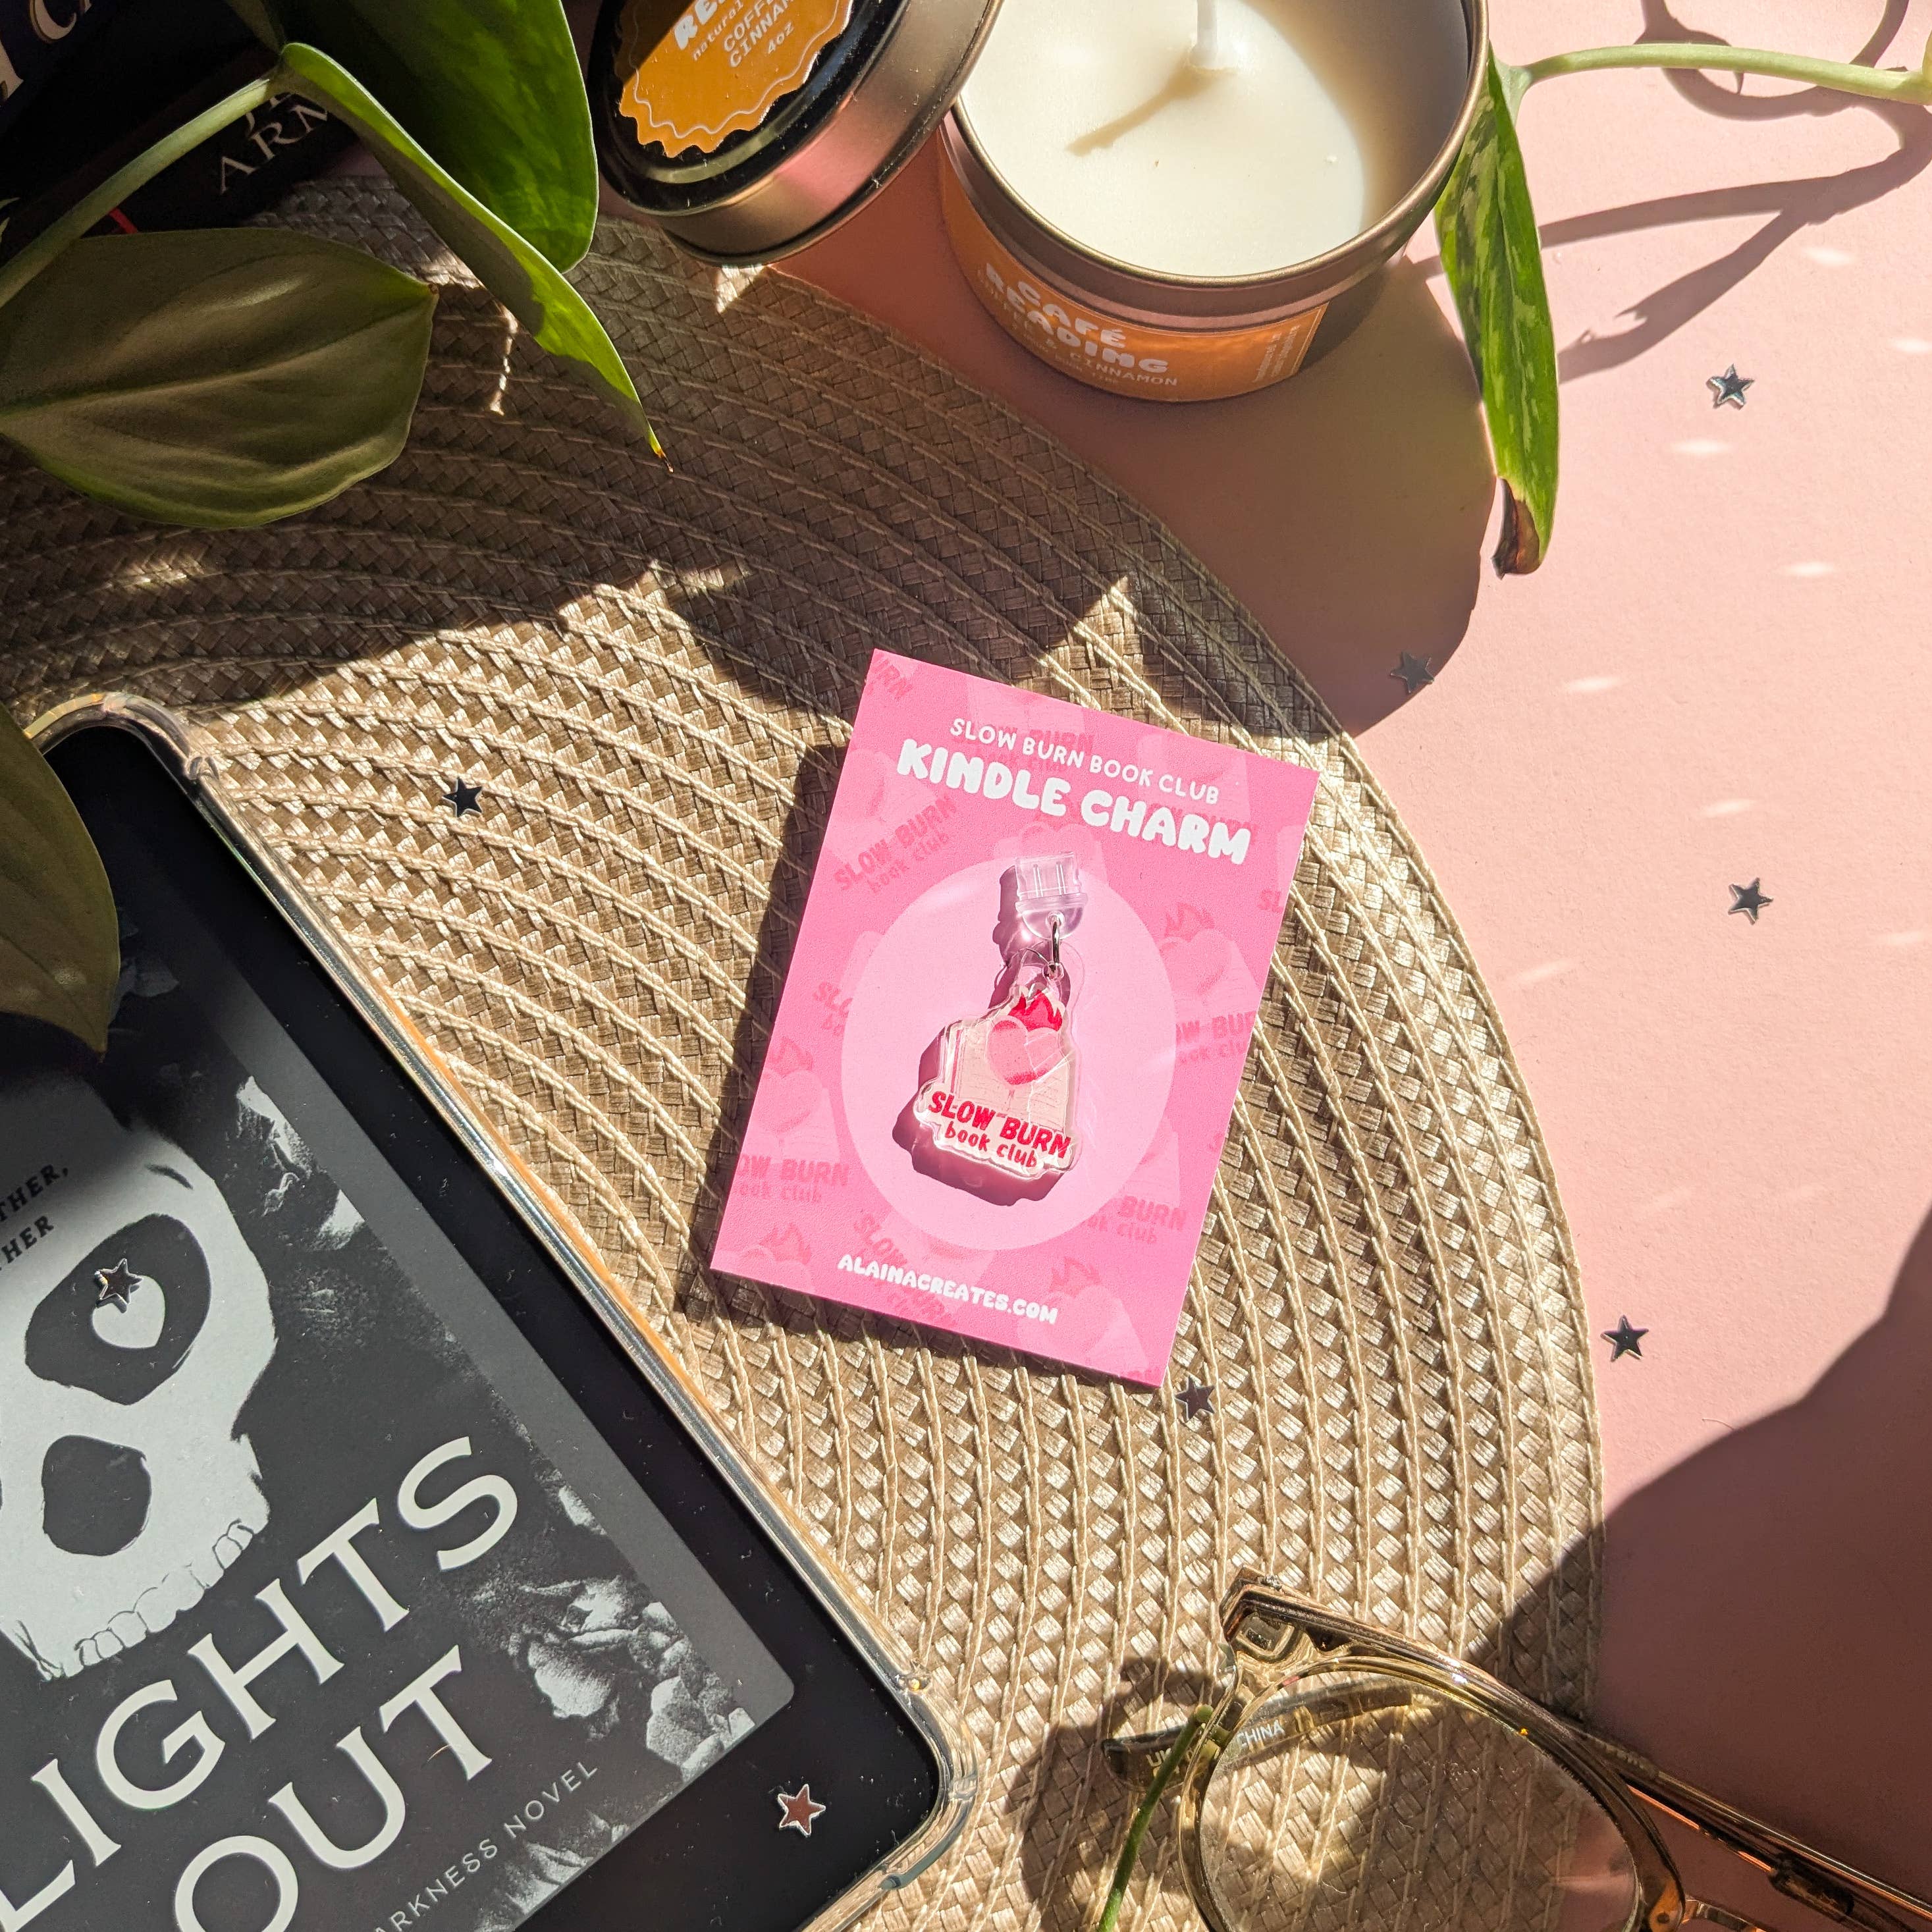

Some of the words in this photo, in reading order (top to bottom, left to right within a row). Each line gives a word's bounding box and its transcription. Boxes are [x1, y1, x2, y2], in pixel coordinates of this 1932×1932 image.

[724, 0, 774, 52] COFF
[986, 261, 1169, 373] READING
[1018, 281, 1126, 349] CAFÉ
[950, 718, 1017, 751] SLOW
[1022, 737, 1085, 768] BURN
[1089, 755, 1154, 788] BOOK
[1158, 774, 1220, 805] CLUB
[896, 738, 1071, 817] KINDLE
[1081, 789, 1252, 865] CHARM
[834, 839, 892, 891] SLOW
[896, 792, 957, 849] BURN
[928, 1091, 996, 1131] SLOW
[1000, 1117, 1071, 1159] BURN
[945, 1121, 990, 1152] book
[996, 1143, 1037, 1167] club
[780, 1158, 850, 1187] BURN
[837, 1254, 1059, 1325] ALAINACREATES.COM
[174, 1644, 493, 1932] OUT
[375, 1838, 498, 1932] RKNESS
[504, 1762, 598, 1838] NOVEL
